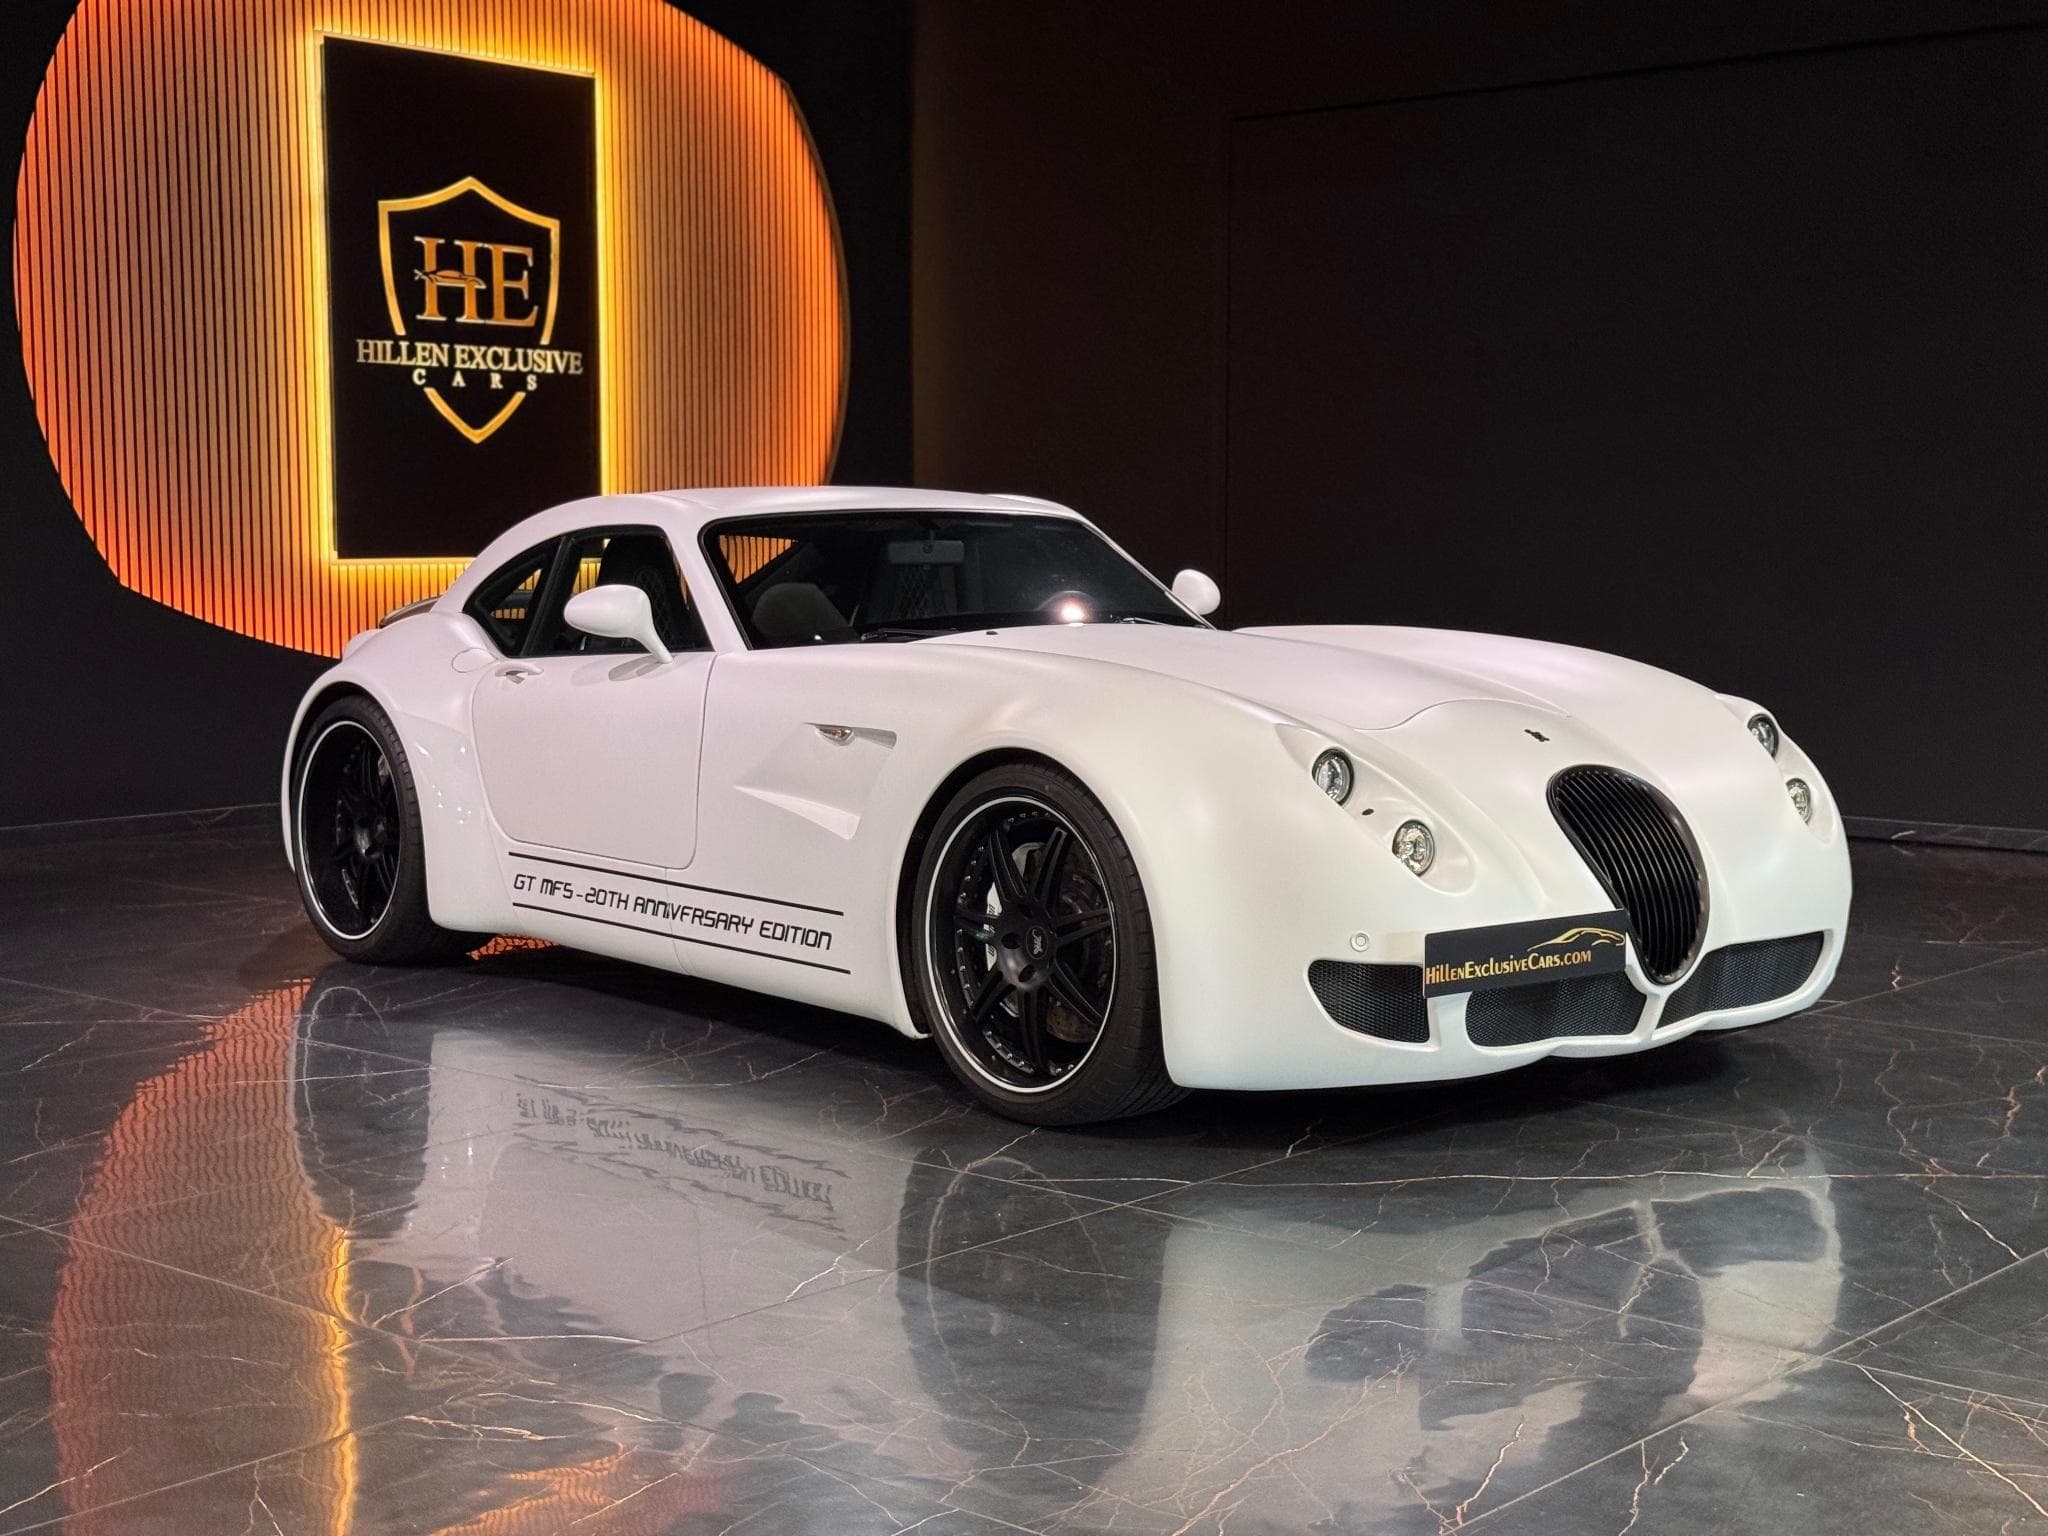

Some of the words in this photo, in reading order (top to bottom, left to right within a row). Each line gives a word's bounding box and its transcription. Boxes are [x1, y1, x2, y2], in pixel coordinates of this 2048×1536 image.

[414, 236, 539, 327] HE
[356, 339, 450, 367] HILLEN
[453, 344, 584, 375] EXCLUSIVE
[412, 368, 538, 391] CARS
[514, 873, 537, 892] GT
[759, 920, 833, 951] EDITION
